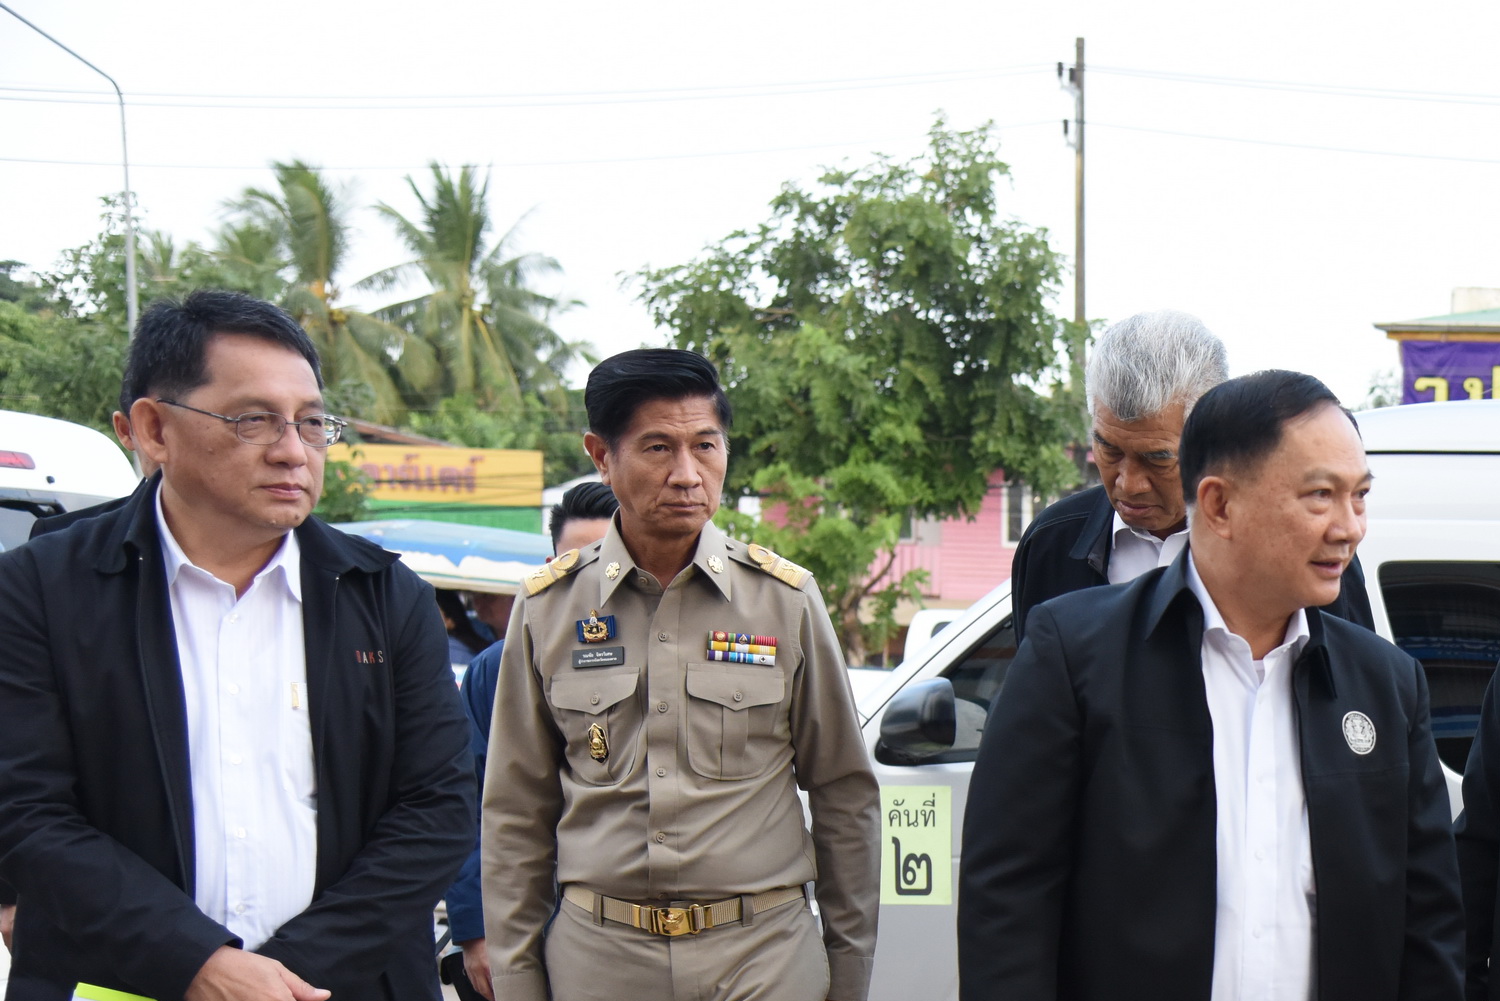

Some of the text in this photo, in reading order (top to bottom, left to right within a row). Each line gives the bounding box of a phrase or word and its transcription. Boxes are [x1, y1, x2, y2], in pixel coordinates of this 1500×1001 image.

[888, 792, 936, 828] คันที่
[891, 836, 933, 896] ๒
